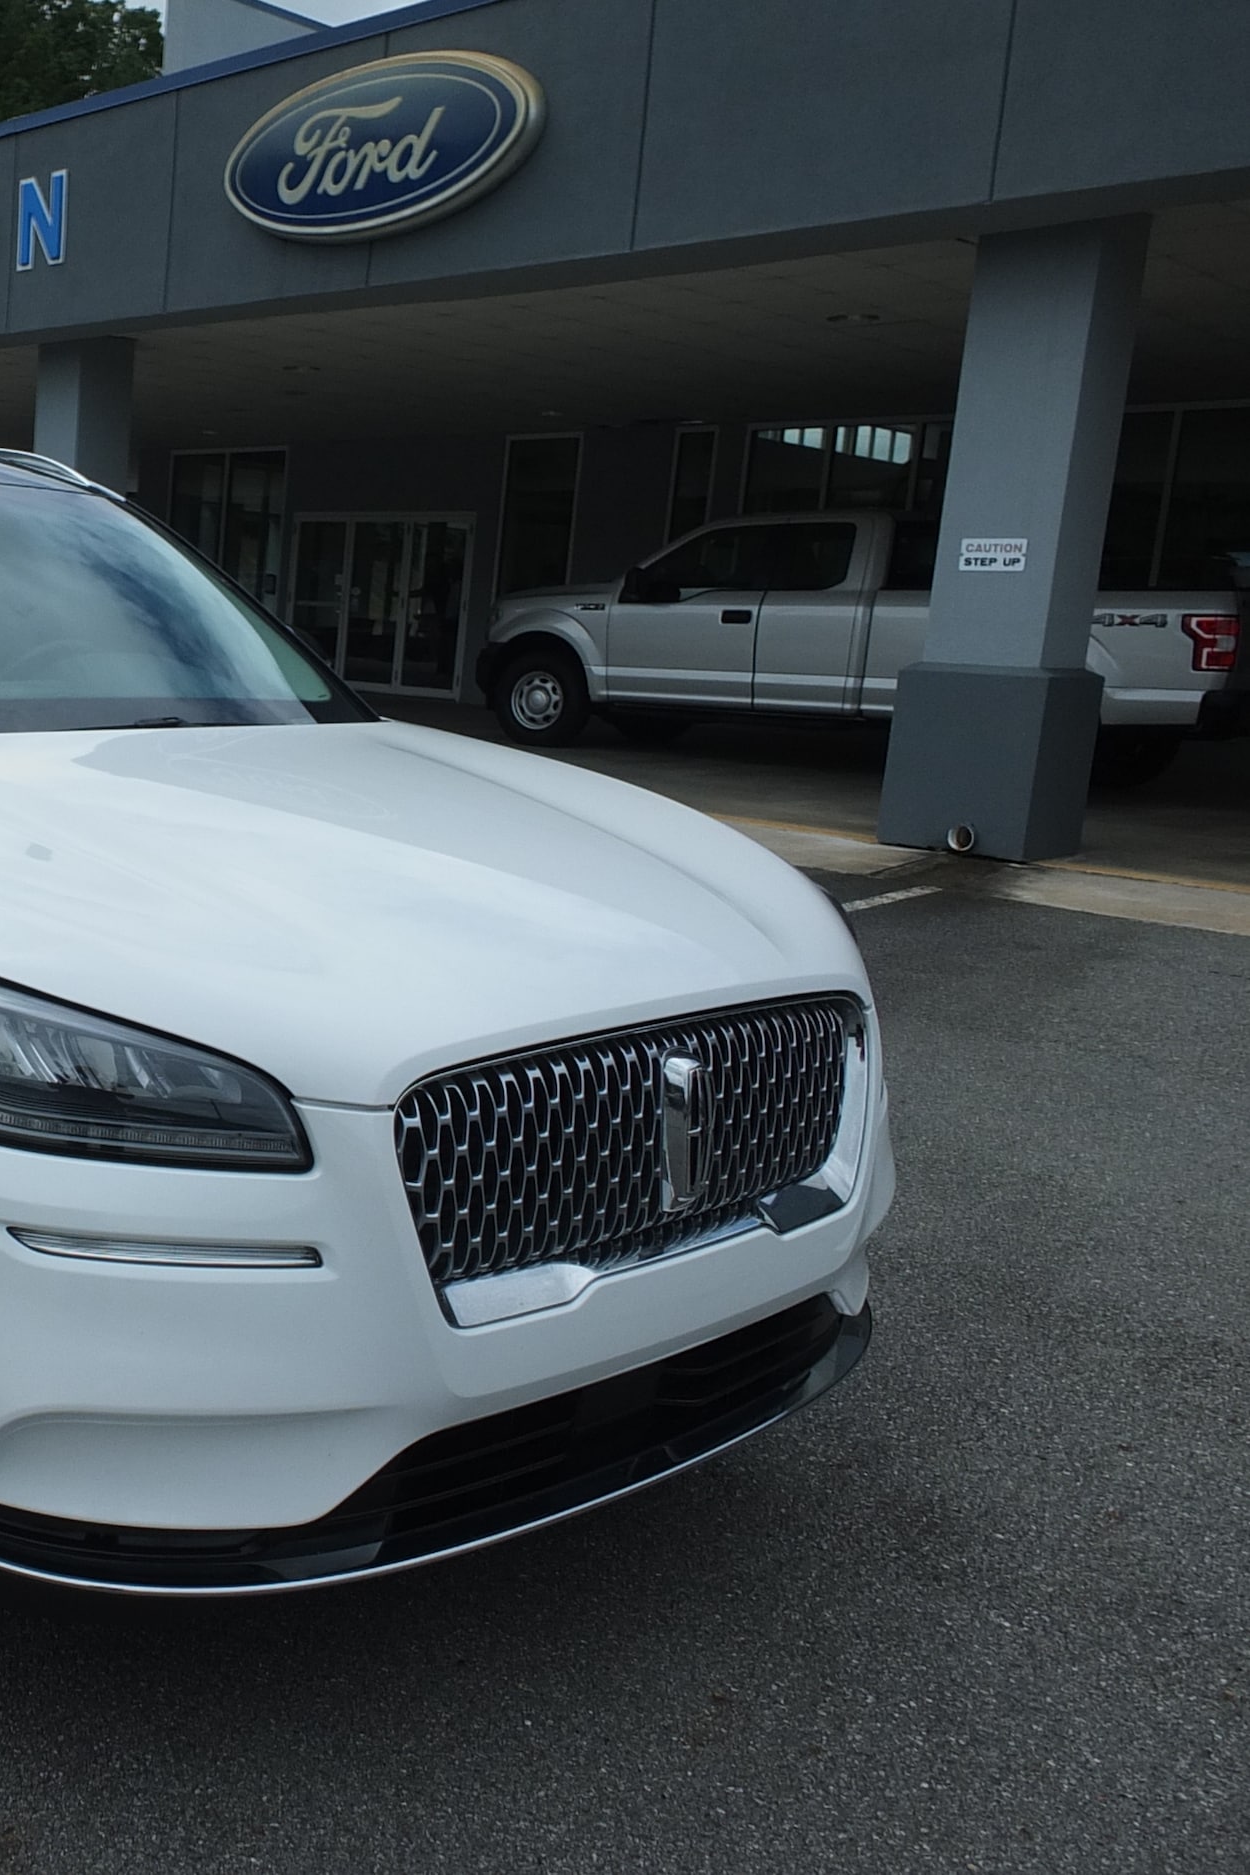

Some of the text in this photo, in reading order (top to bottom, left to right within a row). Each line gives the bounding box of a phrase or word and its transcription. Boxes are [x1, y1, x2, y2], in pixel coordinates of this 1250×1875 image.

[276, 95, 446, 206] Ford
[965, 543, 1023, 553] CAUTION
[963, 557, 1021, 567] STEP UP
